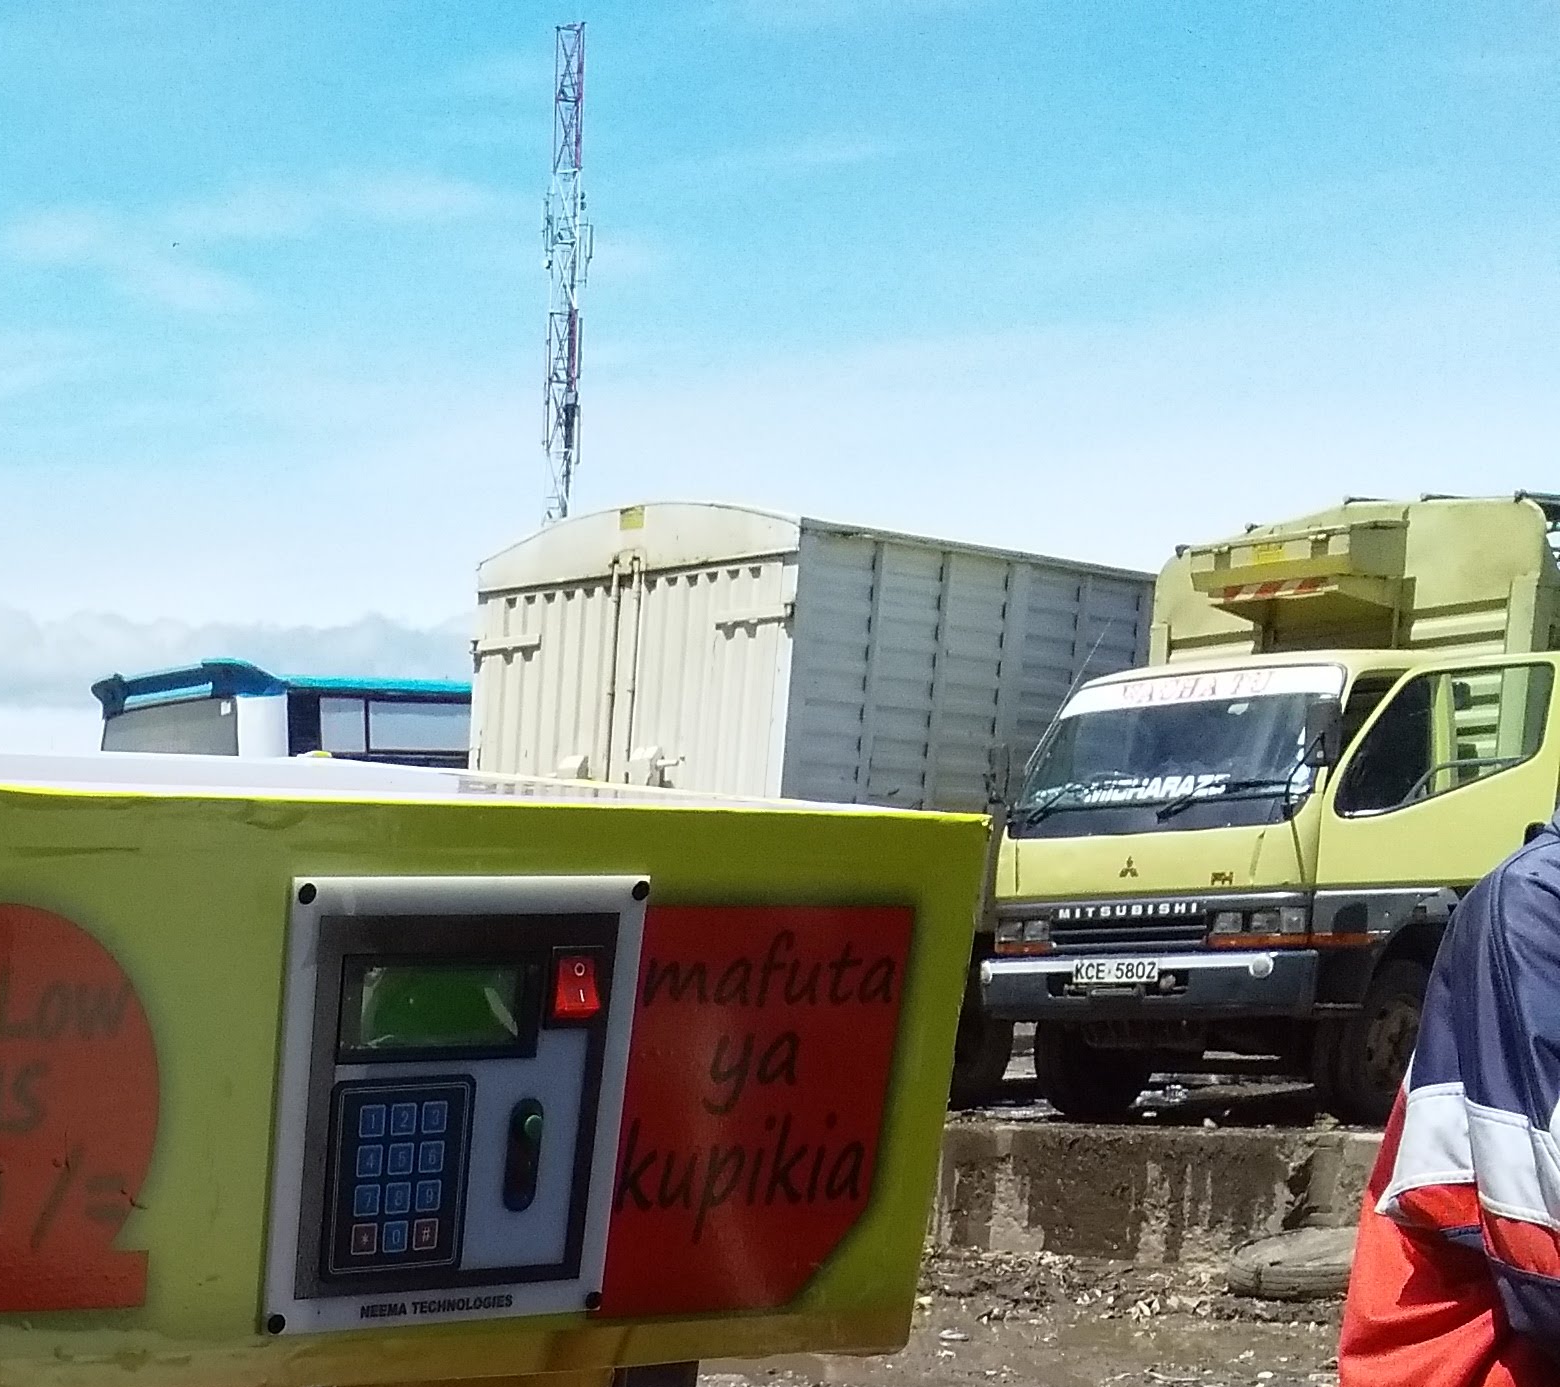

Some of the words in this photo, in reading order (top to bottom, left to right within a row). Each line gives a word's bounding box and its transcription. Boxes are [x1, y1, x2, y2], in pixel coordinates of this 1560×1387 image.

[1058, 902, 1198, 920] MITSUBISHI
[644, 930, 896, 1008] mafuta
[1074, 963, 1106, 981] KCE
[708, 1031, 798, 1116] ya
[617, 1114, 866, 1245] kupikia
[360, 1302, 408, 1319] NEEMA
[411, 1294, 514, 1315] TECHNOLOGIES
